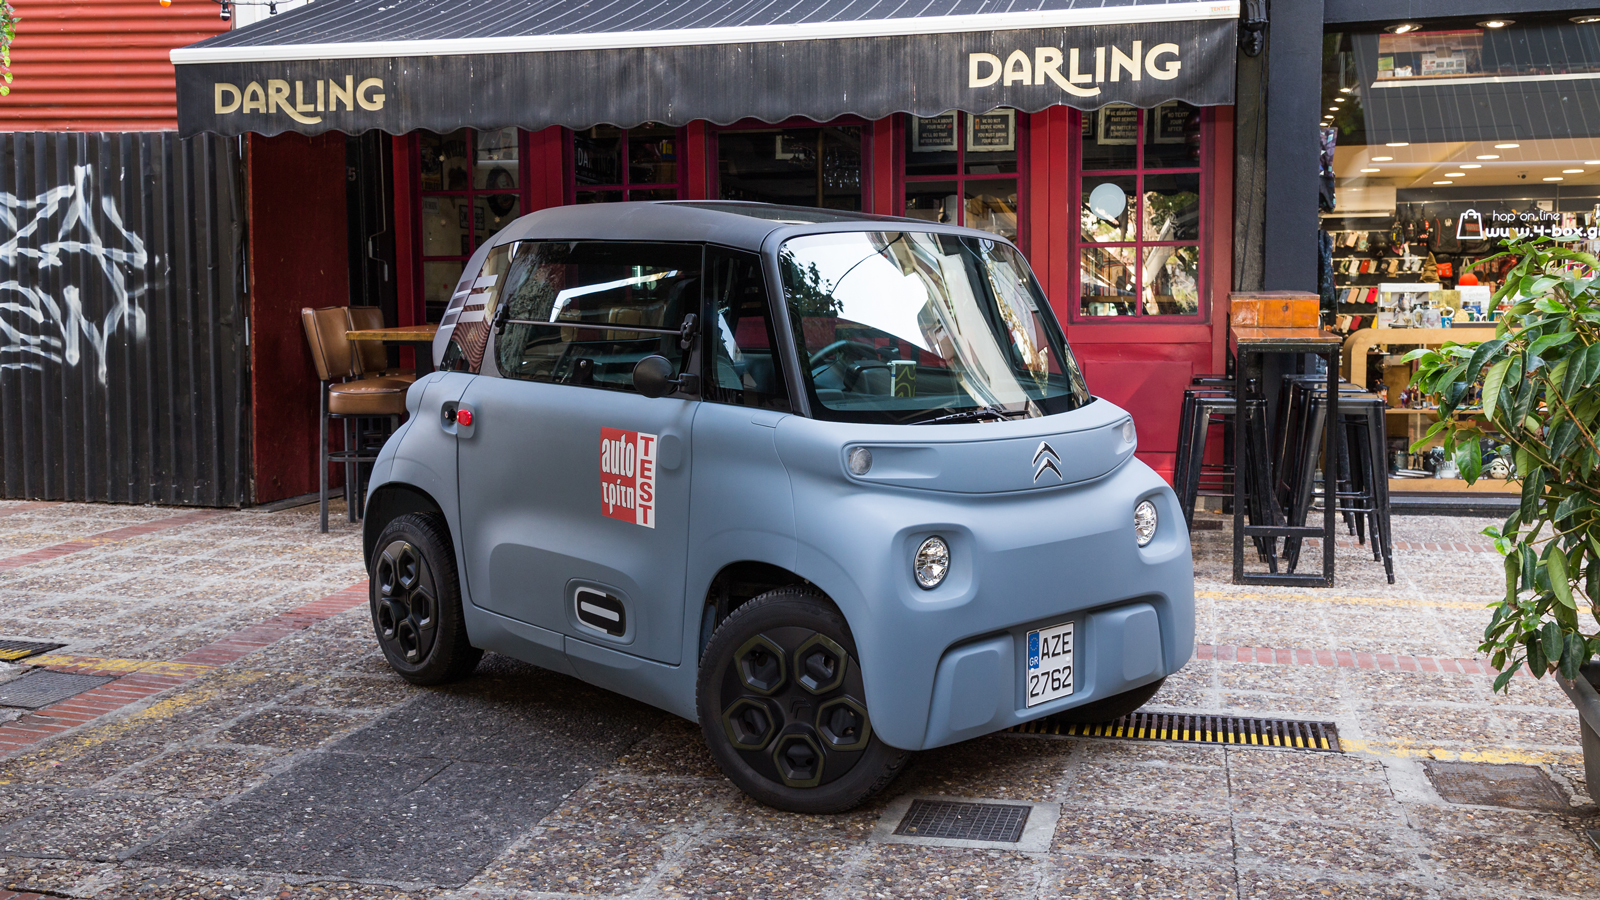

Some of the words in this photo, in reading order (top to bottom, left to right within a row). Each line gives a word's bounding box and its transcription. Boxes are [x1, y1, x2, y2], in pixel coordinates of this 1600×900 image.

[969, 40, 1181, 97] DARLING
[214, 74, 386, 125] DARLING
[348, 166, 356, 182] 5
[1485, 223, 1600, 240] www.4-box.g
[1492, 210, 1516, 223] hop
[1519, 213, 1535, 221] on
[1539, 210, 1560, 221] line
[601, 433, 635, 478] auto
[639, 435, 655, 525] TEST
[1029, 656, 1039, 666] GR
[1041, 631, 1072, 660] AZE
[1030, 665, 1072, 698] 2762
